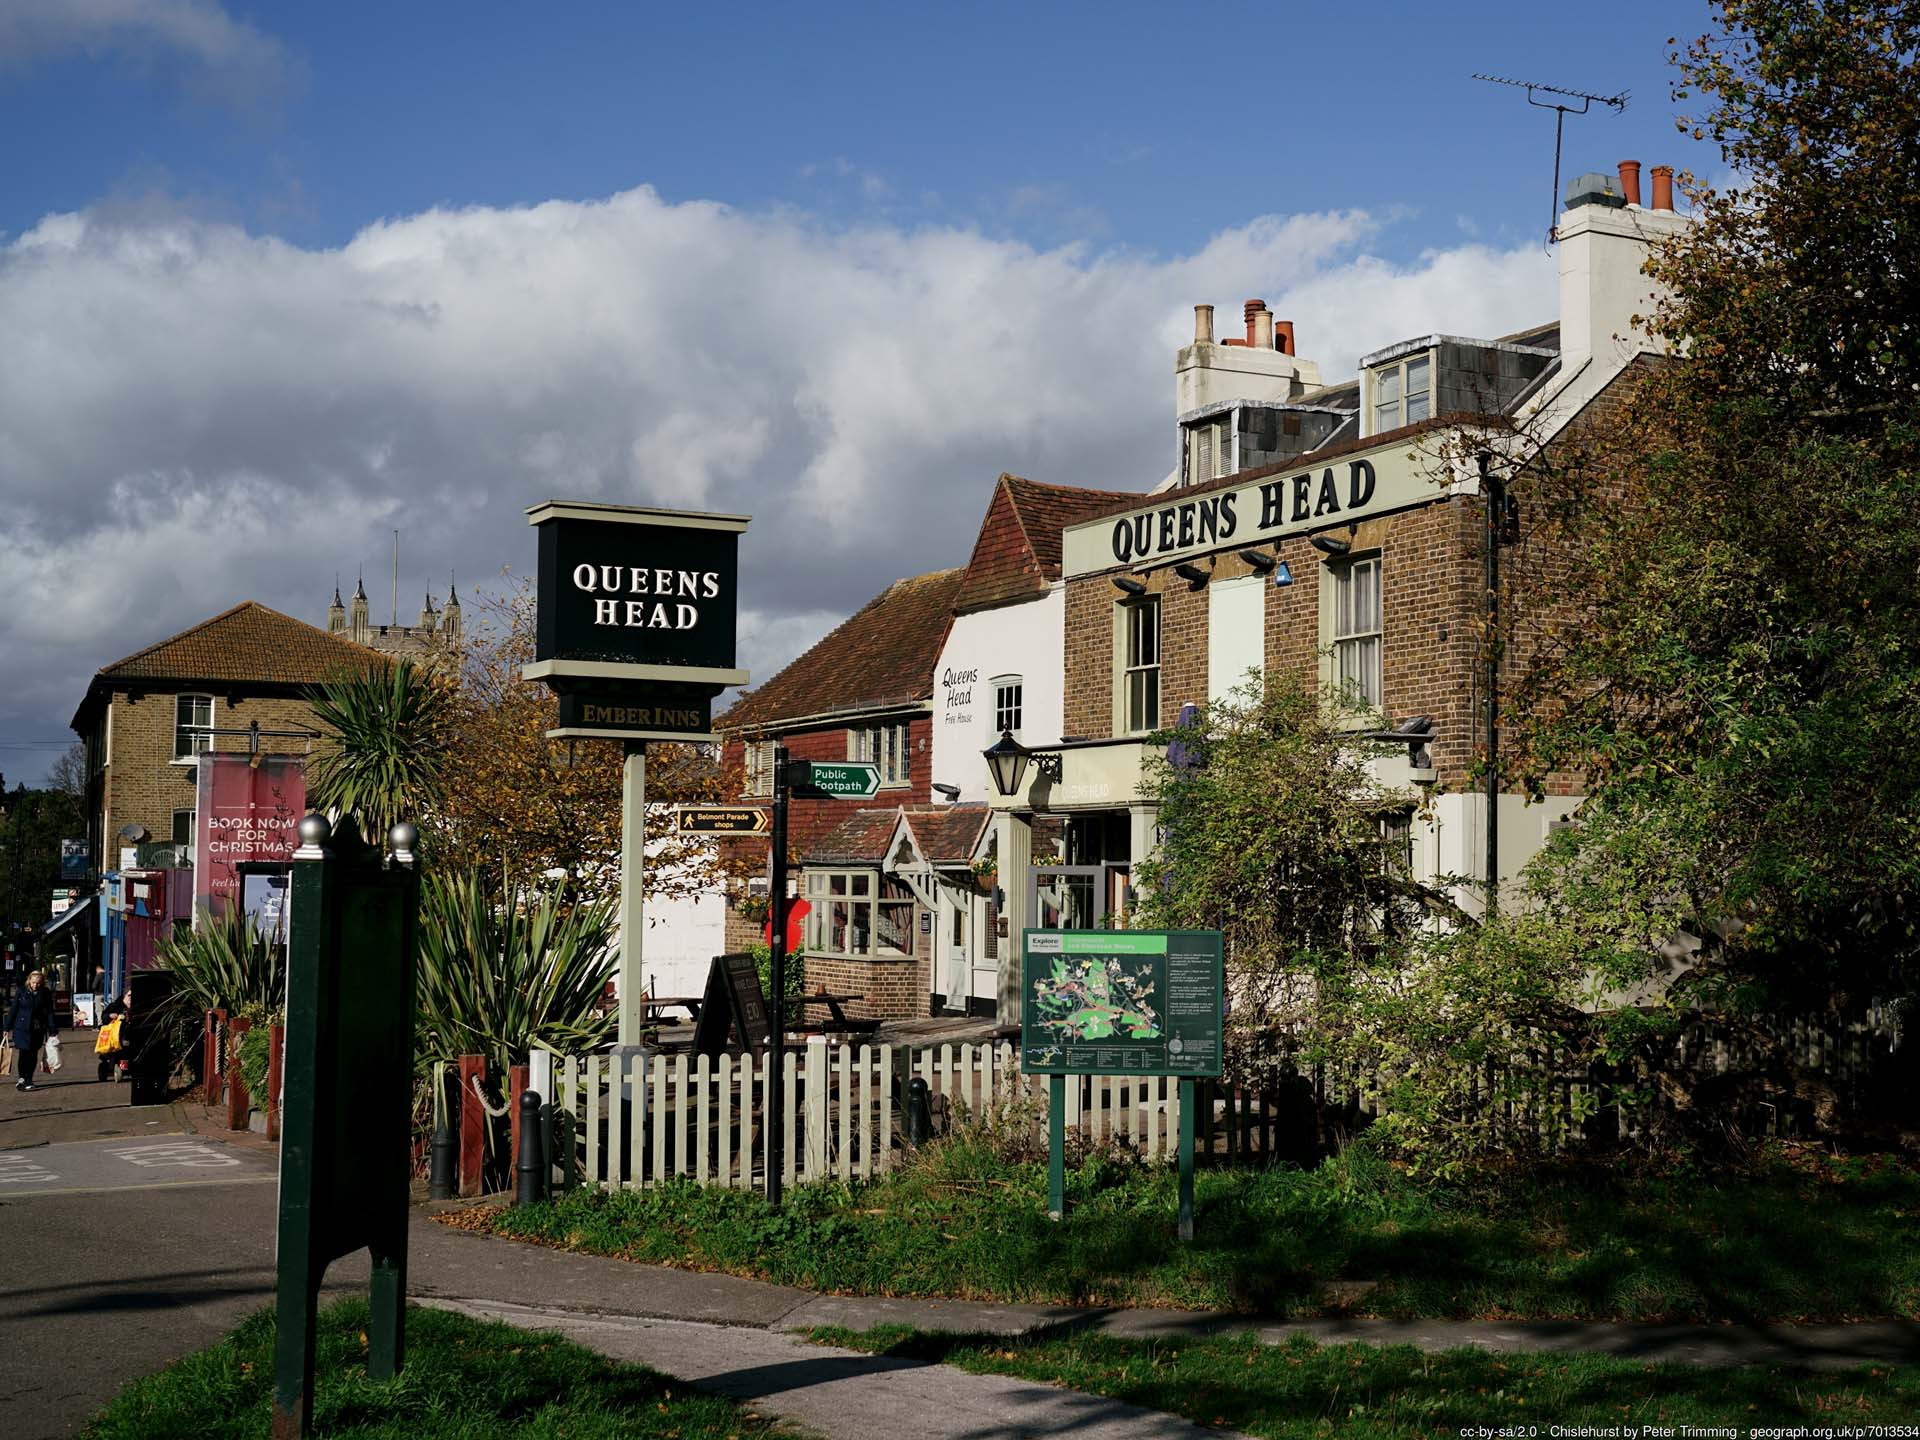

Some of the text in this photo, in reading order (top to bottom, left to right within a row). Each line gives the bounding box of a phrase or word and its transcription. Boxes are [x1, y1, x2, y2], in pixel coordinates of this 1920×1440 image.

[1112, 459, 1376, 563] QUEENS HEAD
[573, 563, 720, 600] QUEENS
[594, 599, 699, 630] HEAD
[942, 667, 978, 688] Queens
[947, 685, 972, 709] Head
[583, 704, 700, 728] EMBER INNS
[815, 769, 847, 780] Public
[815, 781, 862, 792] Footpath
[697, 813, 749, 821] Belmont Parade
[208, 817, 296, 829] BOOK NOW
[714, 821, 734, 829] shops
[237, 830, 267, 841] FOR
[64, 847, 88, 855] TO LET
[208, 841, 294, 853] CHRISTMAS
[211, 879, 228, 887] Feel
[1032, 938, 1059, 946] Explore
